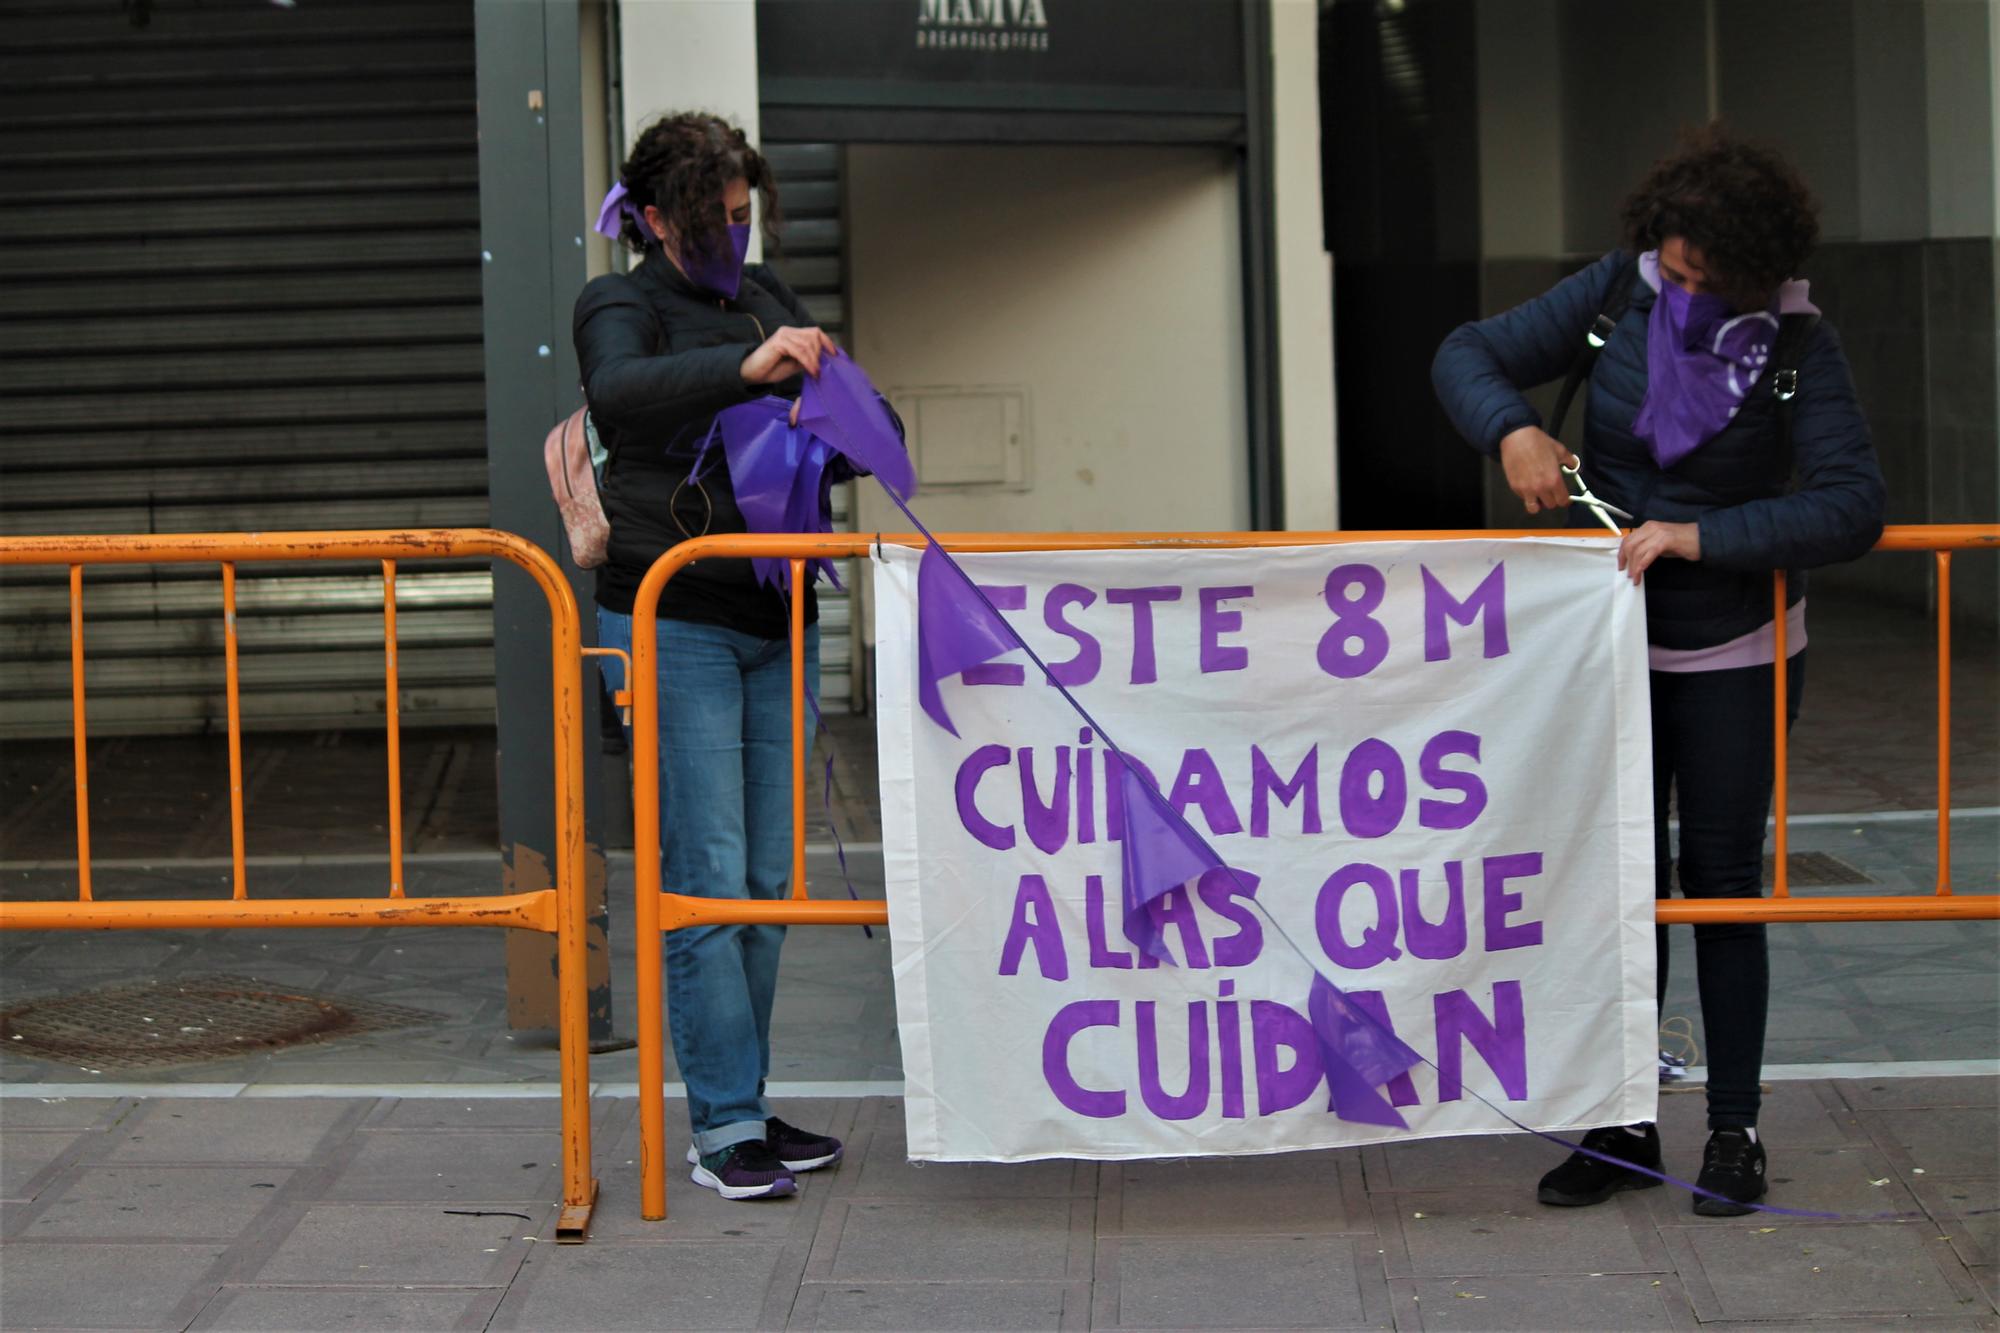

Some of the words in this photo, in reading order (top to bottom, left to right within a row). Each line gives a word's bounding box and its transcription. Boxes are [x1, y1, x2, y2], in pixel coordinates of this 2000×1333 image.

[998, 874, 1069, 982] A
[1085, 866, 1264, 969] ALAS
[1315, 852, 1543, 970] QUE
